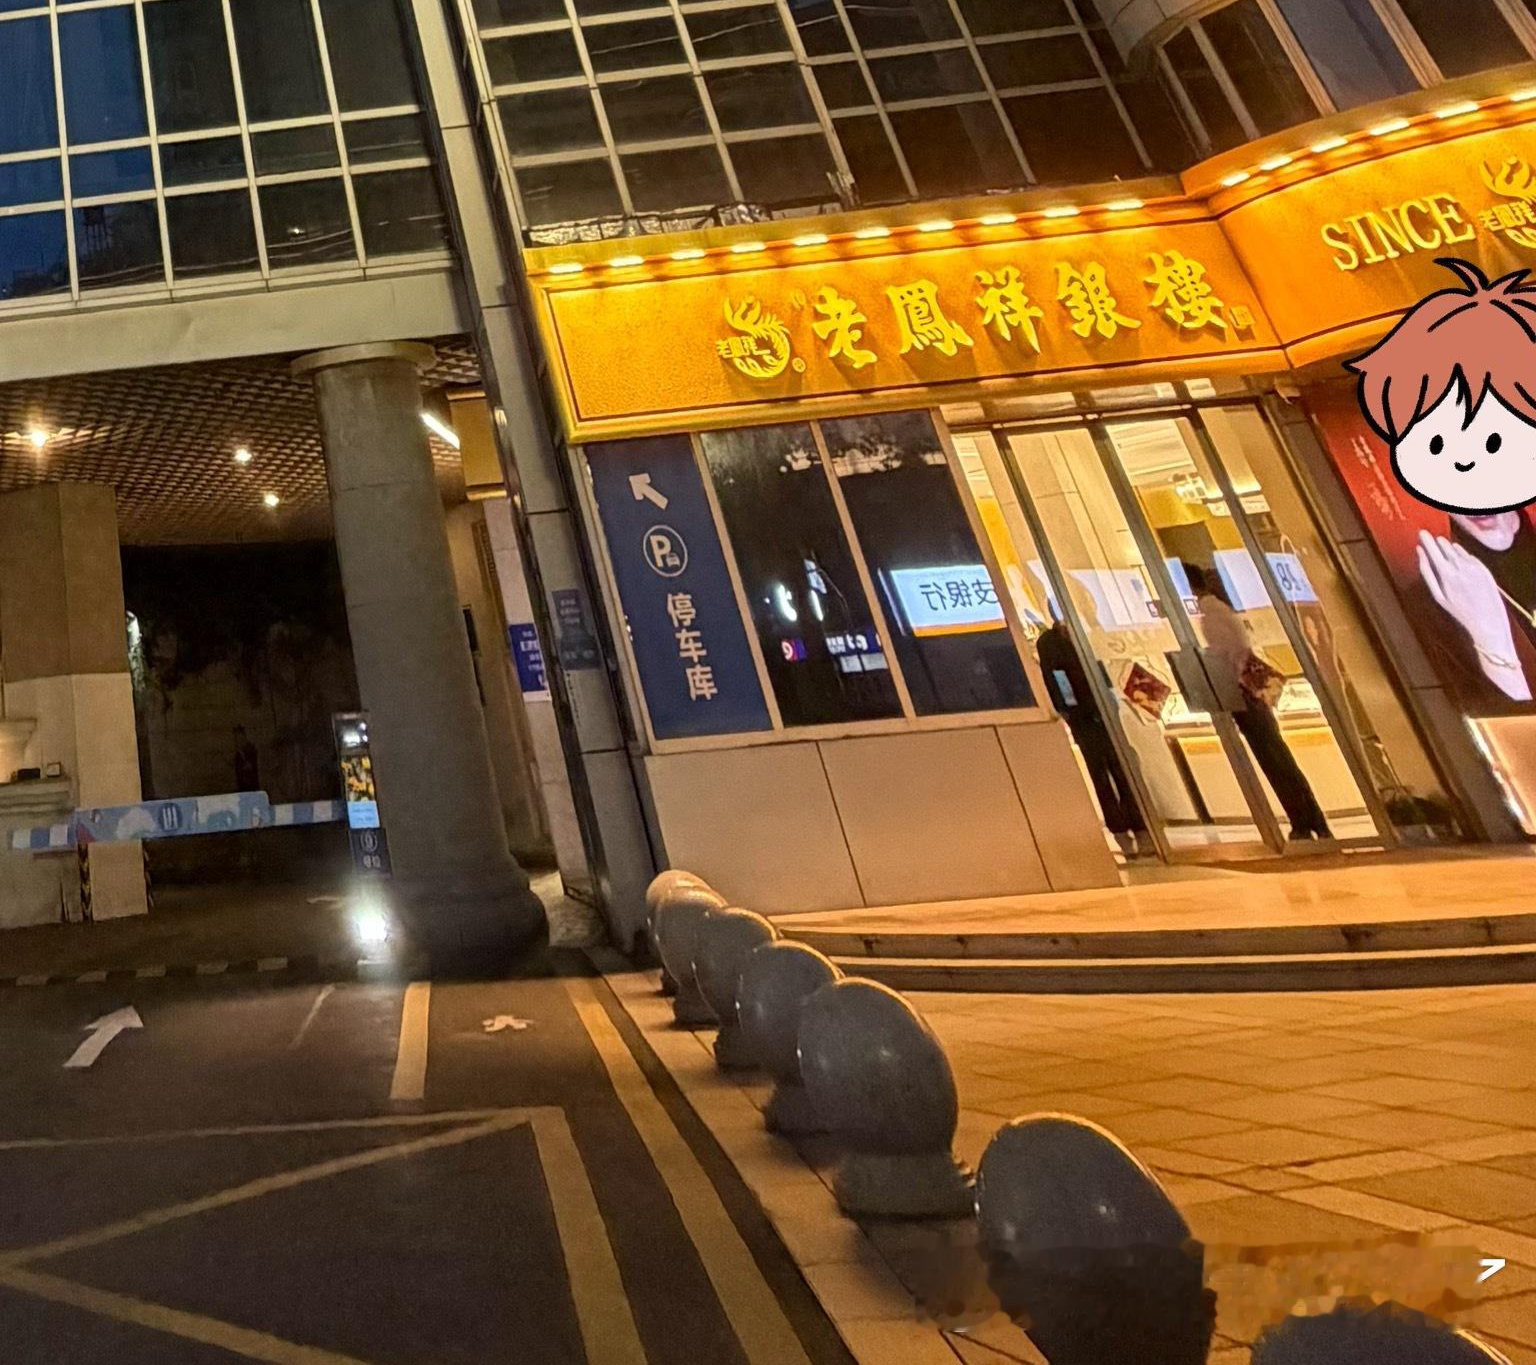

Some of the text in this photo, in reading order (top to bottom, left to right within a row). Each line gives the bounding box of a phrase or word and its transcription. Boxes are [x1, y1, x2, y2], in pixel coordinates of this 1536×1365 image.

[1320, 192, 1476, 271] SINCE
[667, 593, 718, 702] 停车库
